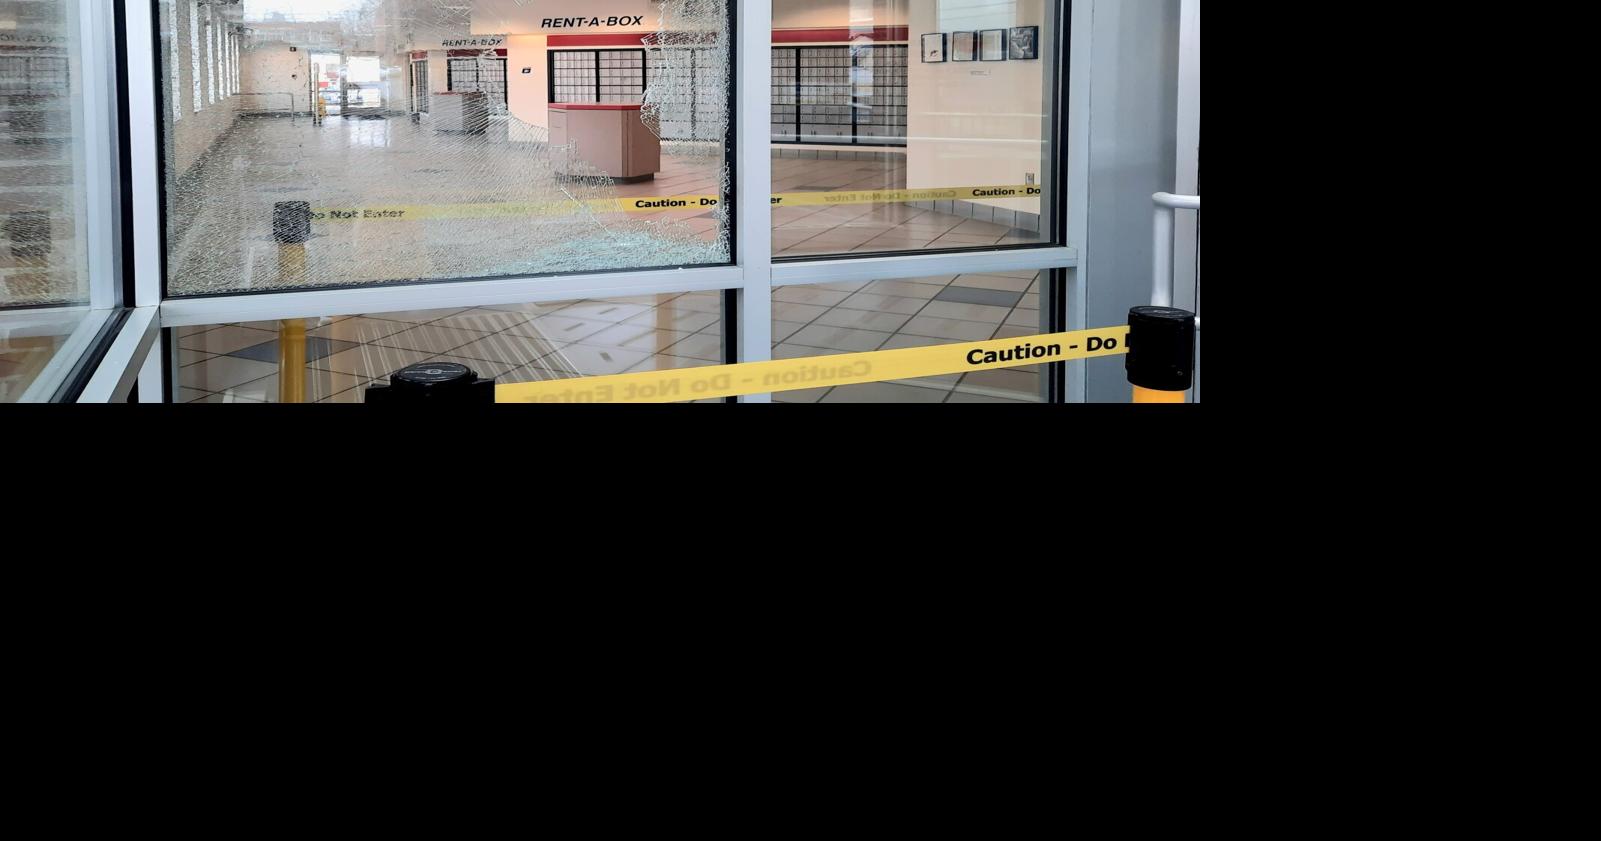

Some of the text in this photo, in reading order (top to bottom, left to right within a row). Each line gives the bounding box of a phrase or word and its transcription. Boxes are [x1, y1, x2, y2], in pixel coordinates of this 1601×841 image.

[541, 15, 644, 28] RENT-A-BOX
[972, 188, 1015, 196] Caution
[1026, 187, 1041, 195] Do
[635, 198, 686, 208] Caution
[700, 198, 717, 206] Do
[330, 210, 358, 218] Not
[363, 209, 405, 218] Enter
[966, 343, 1061, 365] Caution
[1086, 336, 1117, 352] Do
